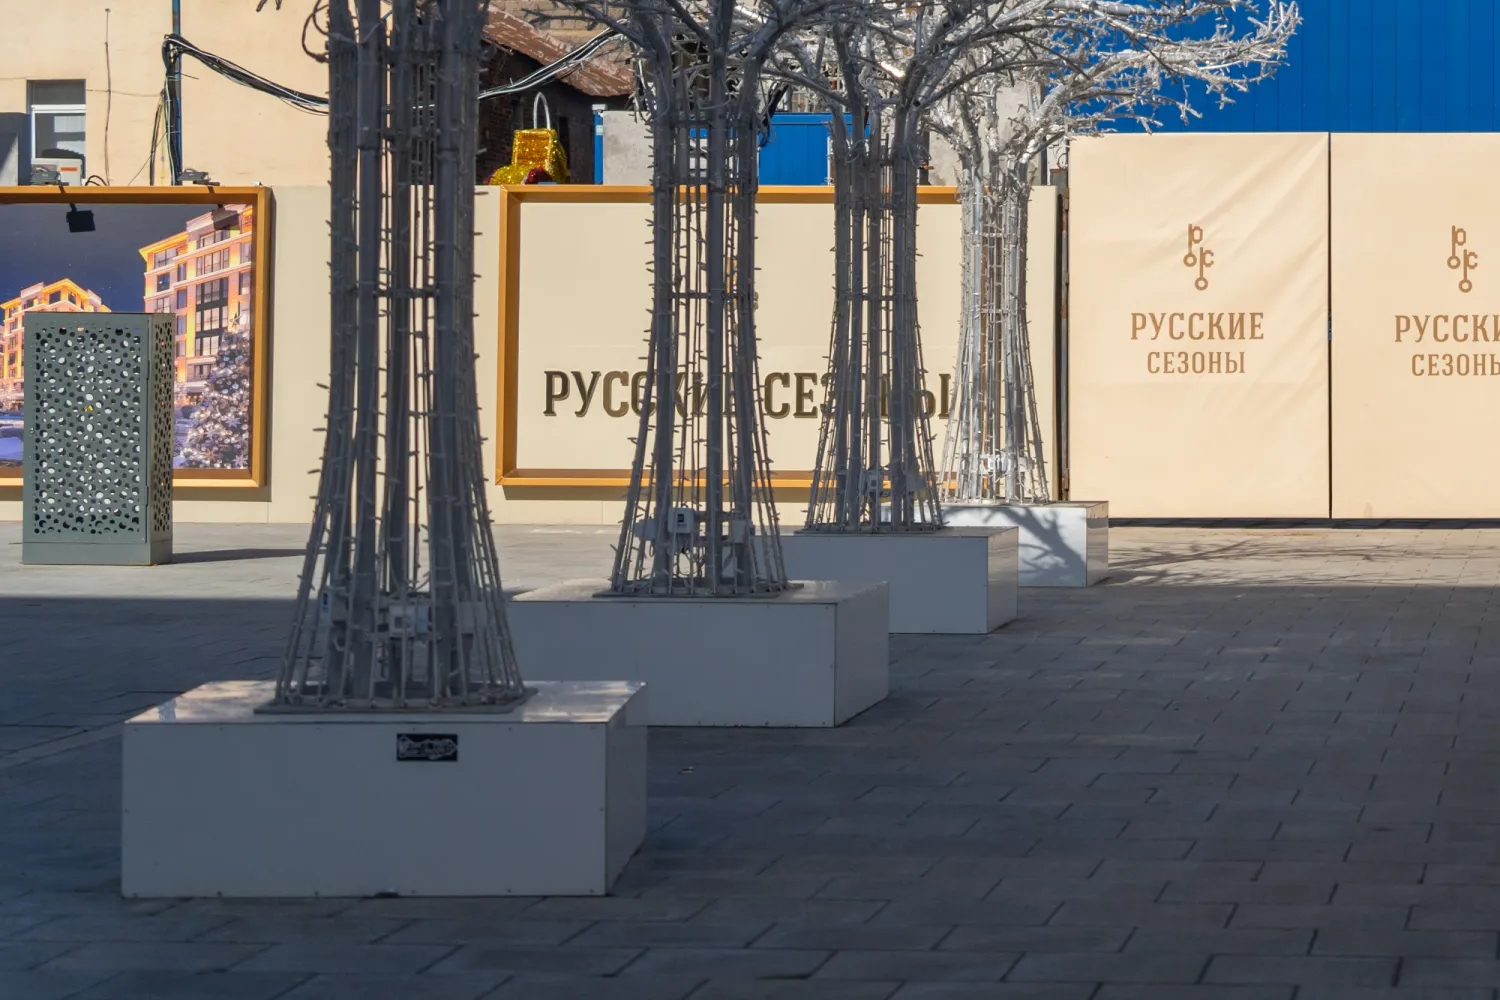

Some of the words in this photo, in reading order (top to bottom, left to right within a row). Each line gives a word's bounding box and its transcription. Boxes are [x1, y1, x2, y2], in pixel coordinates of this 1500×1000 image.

[1131, 312, 1265, 340] РУССКИЕ
[1147, 351, 1246, 375] СЕЗОНЫ
[543, 370, 751, 419] РУССИ
[764, 371, 952, 420] СЕЫ
